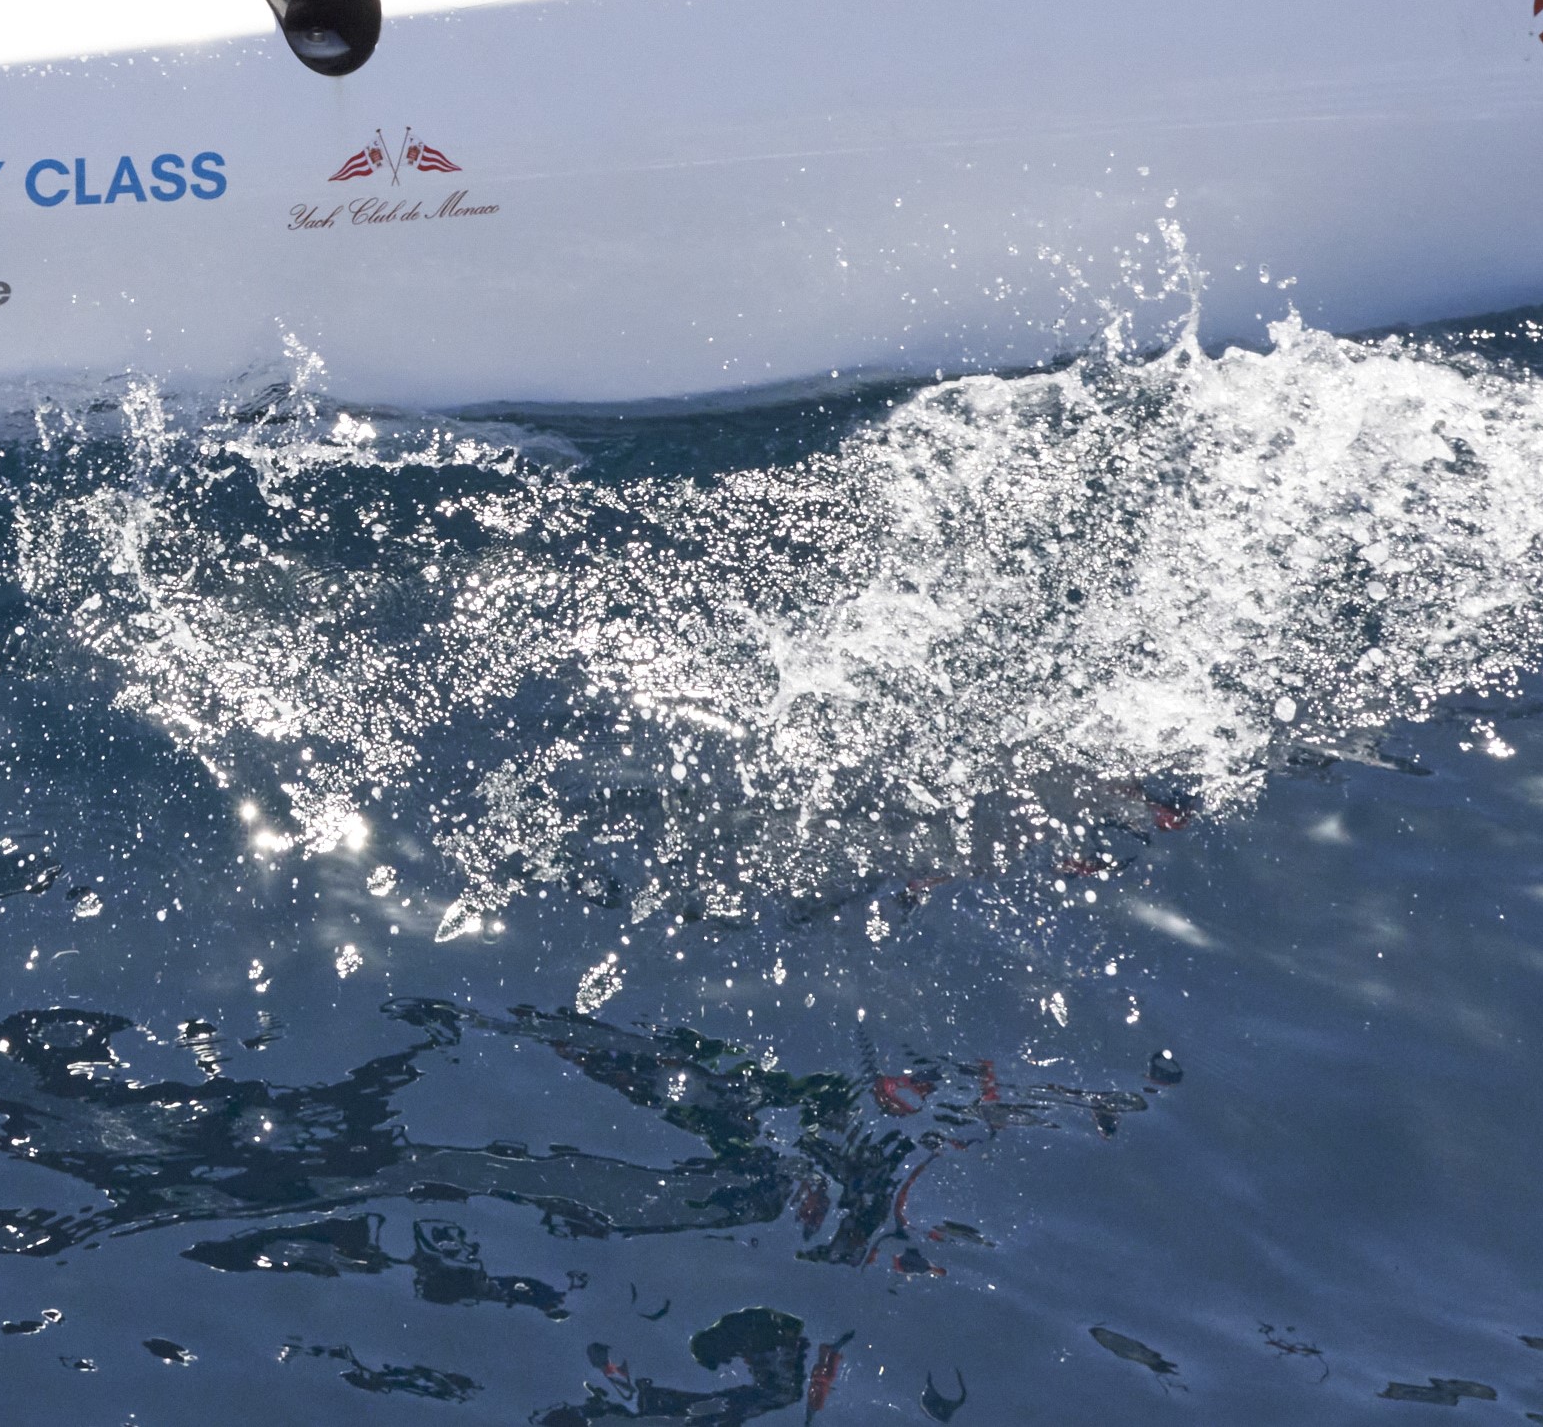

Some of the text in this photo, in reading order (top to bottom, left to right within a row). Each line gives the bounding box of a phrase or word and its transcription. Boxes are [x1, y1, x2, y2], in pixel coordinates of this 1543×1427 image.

[24, 151, 228, 207] CLASS
[348, 196, 407, 226] Club
[401, 201, 423, 222] de
[424, 189, 501, 220] Monaco
